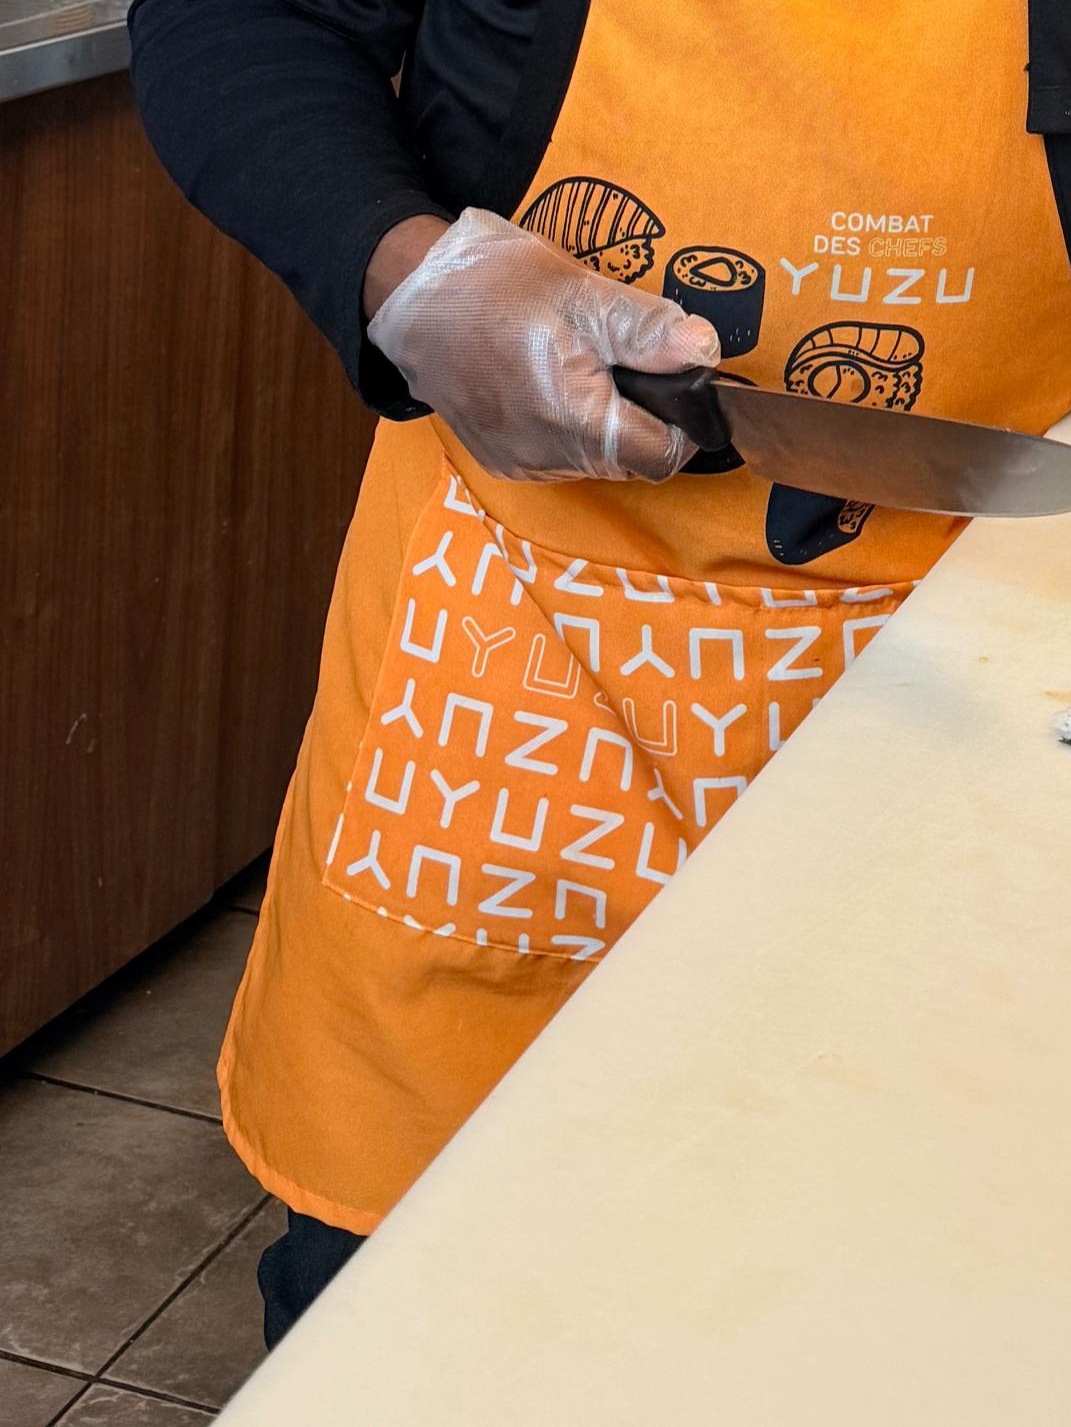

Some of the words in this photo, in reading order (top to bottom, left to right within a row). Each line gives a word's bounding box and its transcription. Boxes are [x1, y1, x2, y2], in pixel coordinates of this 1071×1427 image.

[831, 211, 934, 234] COMBAT
[813, 234, 861, 256] DES
[868, 237, 947, 257] CHEFS
[780, 257, 975, 305] YUZU
